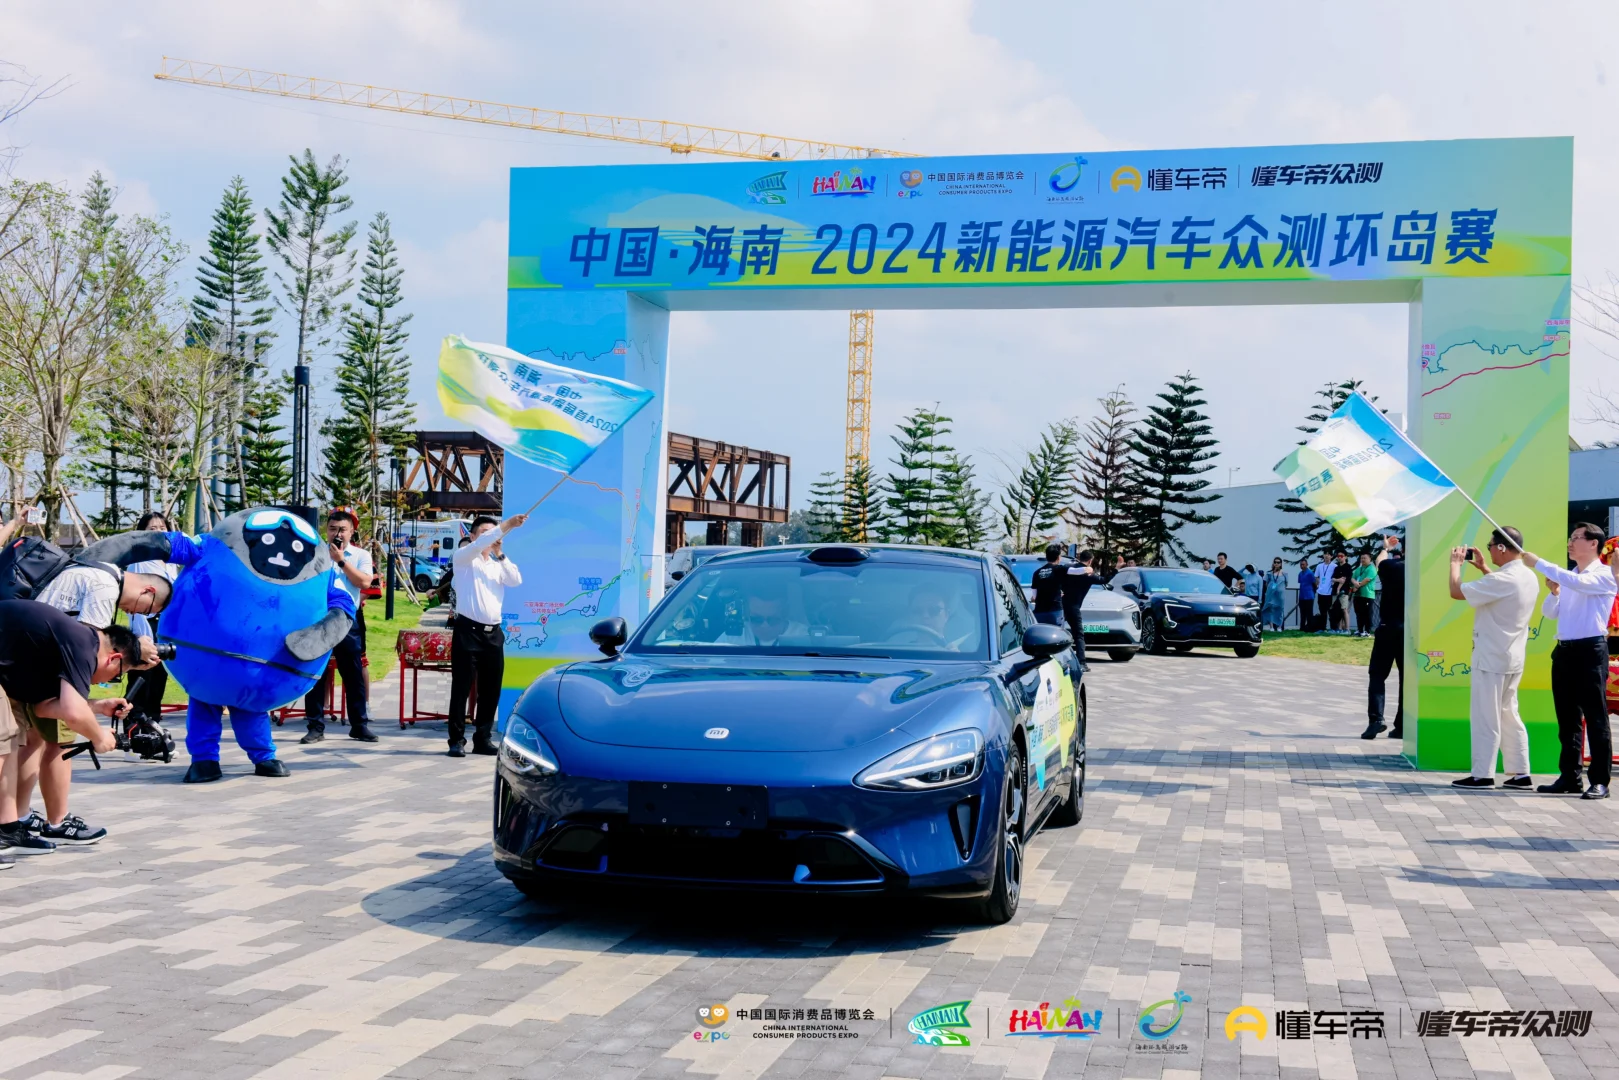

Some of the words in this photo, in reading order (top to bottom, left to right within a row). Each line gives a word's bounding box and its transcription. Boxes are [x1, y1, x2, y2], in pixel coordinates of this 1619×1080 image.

[927, 170, 1025, 182] 中国国际消费品博览会
[1147, 167, 1227, 191] 懂车帝
[1250, 162, 1383, 187] 懂车帝众测
[569, 224, 784, 278] 中国·海南
[811, 207, 1498, 275] 2024新能源汽车众测环岛赛
